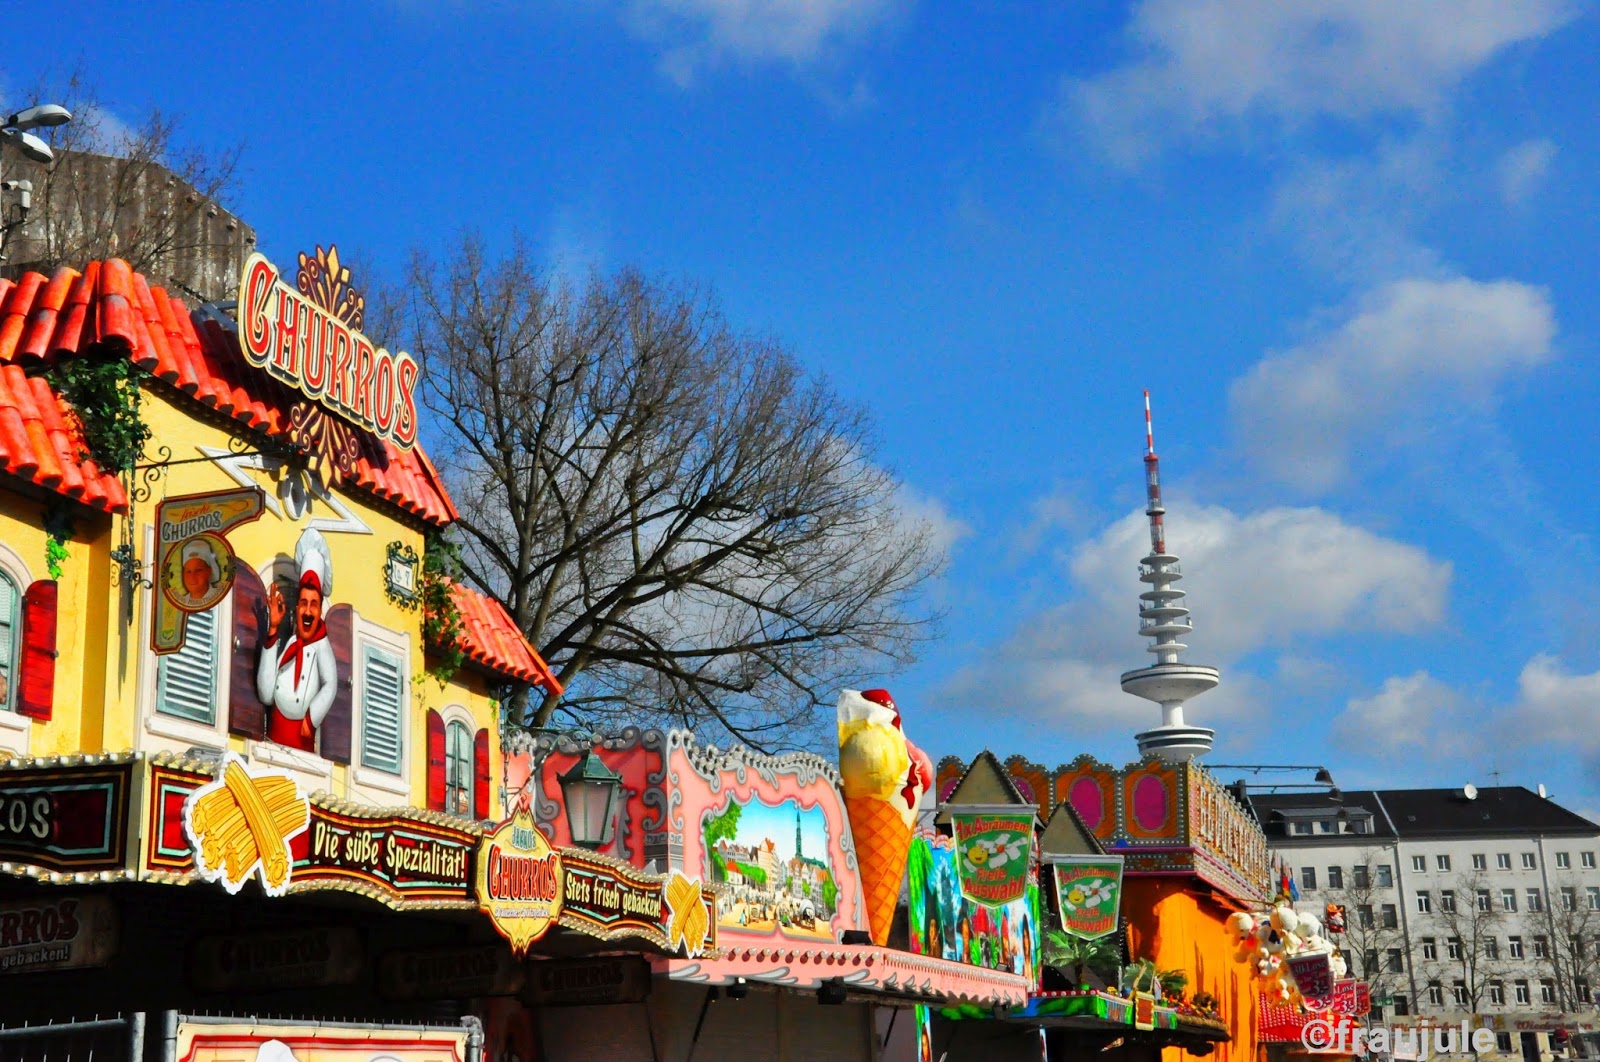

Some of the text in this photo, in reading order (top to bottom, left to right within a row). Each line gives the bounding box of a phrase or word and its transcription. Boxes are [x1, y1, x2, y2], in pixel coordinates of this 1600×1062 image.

[244, 260, 418, 446] CHURROS
[162, 511, 223, 541] CHURROS
[314, 821, 465, 879] Die süße Spezialität!
[487, 843, 558, 902] CHURROS
[976, 866, 1006, 880] Freie
[566, 872, 662, 918] Stets frisch gebacken!
[1076, 907, 1100, 917] Freie
